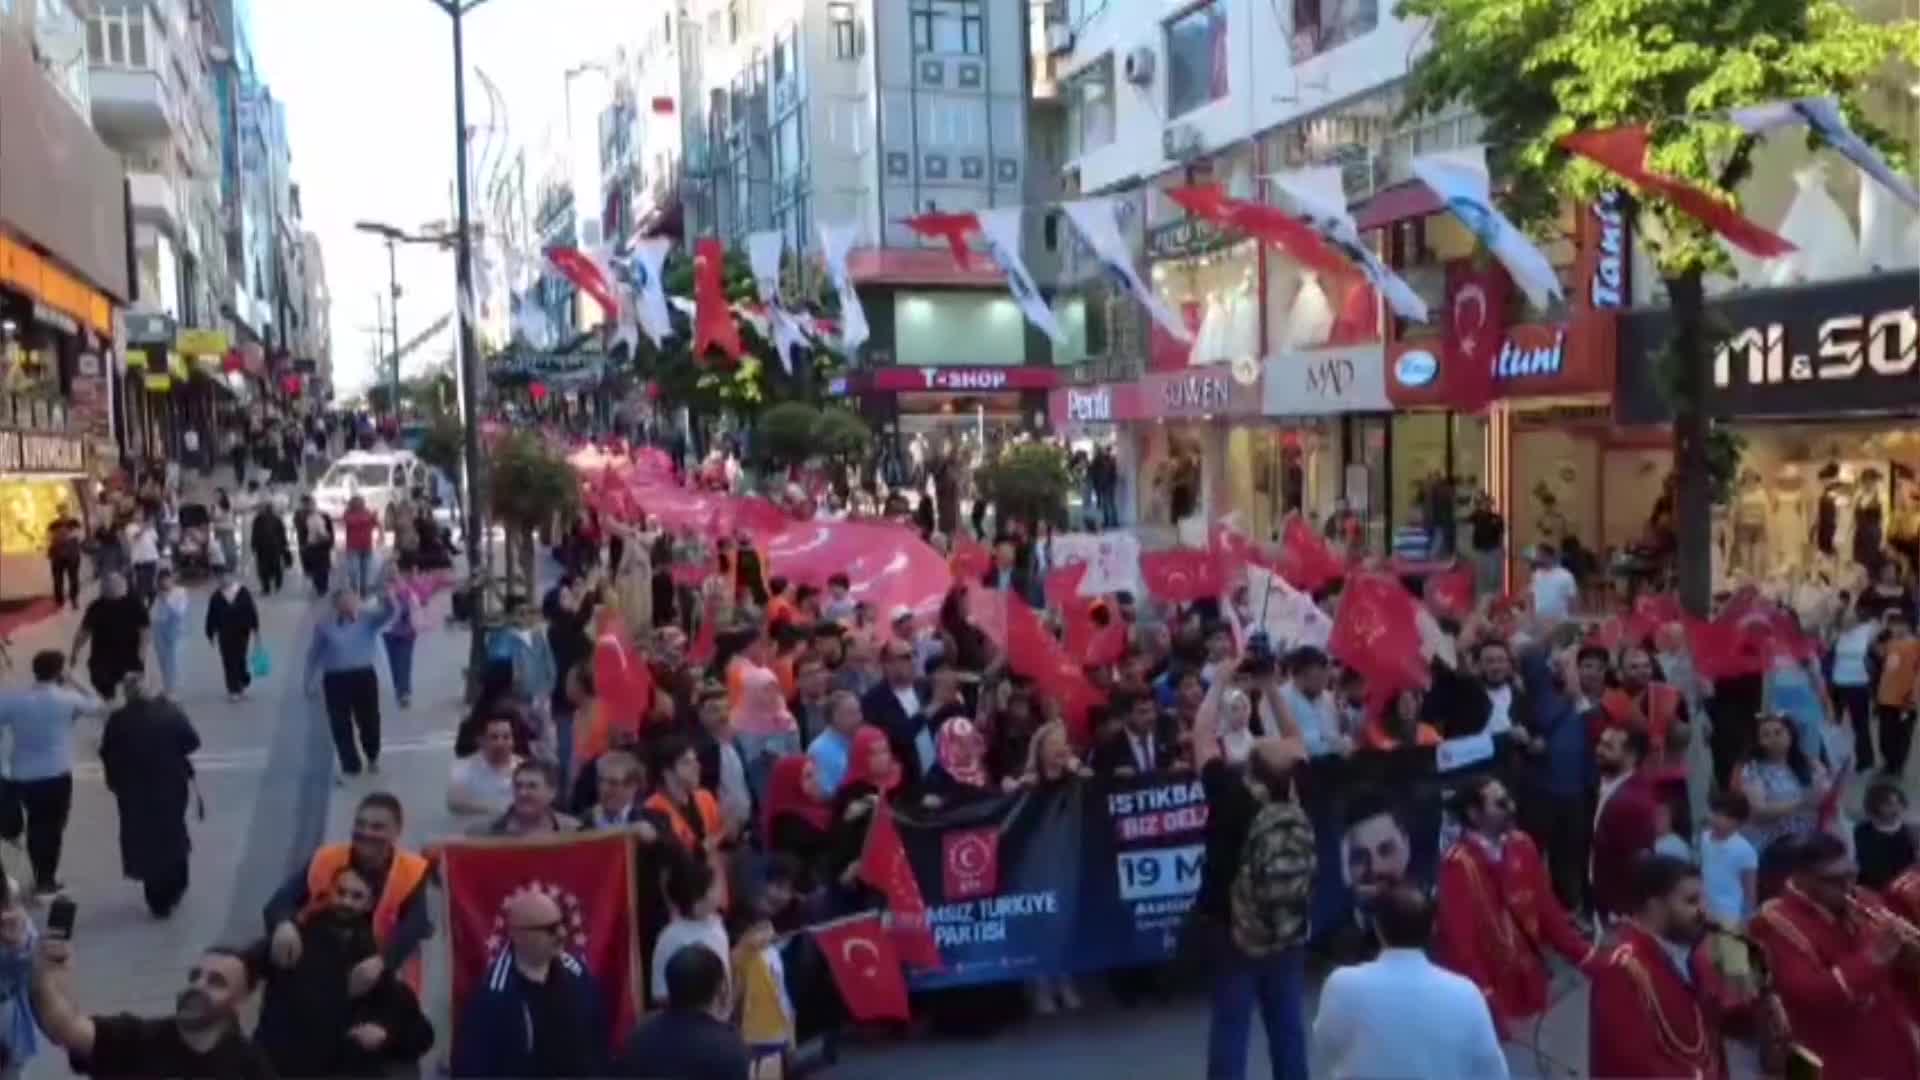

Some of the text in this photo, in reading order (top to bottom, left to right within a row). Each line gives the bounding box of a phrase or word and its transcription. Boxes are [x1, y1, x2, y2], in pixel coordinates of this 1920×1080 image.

[1592, 192, 1621, 306] Tant
[1490, 330, 1564, 380] tuni
[920, 367, 1008, 389] T-SHOP
[1108, 781, 1206, 815] İSTİKBA
[1121, 852, 1205, 888] 19 M
